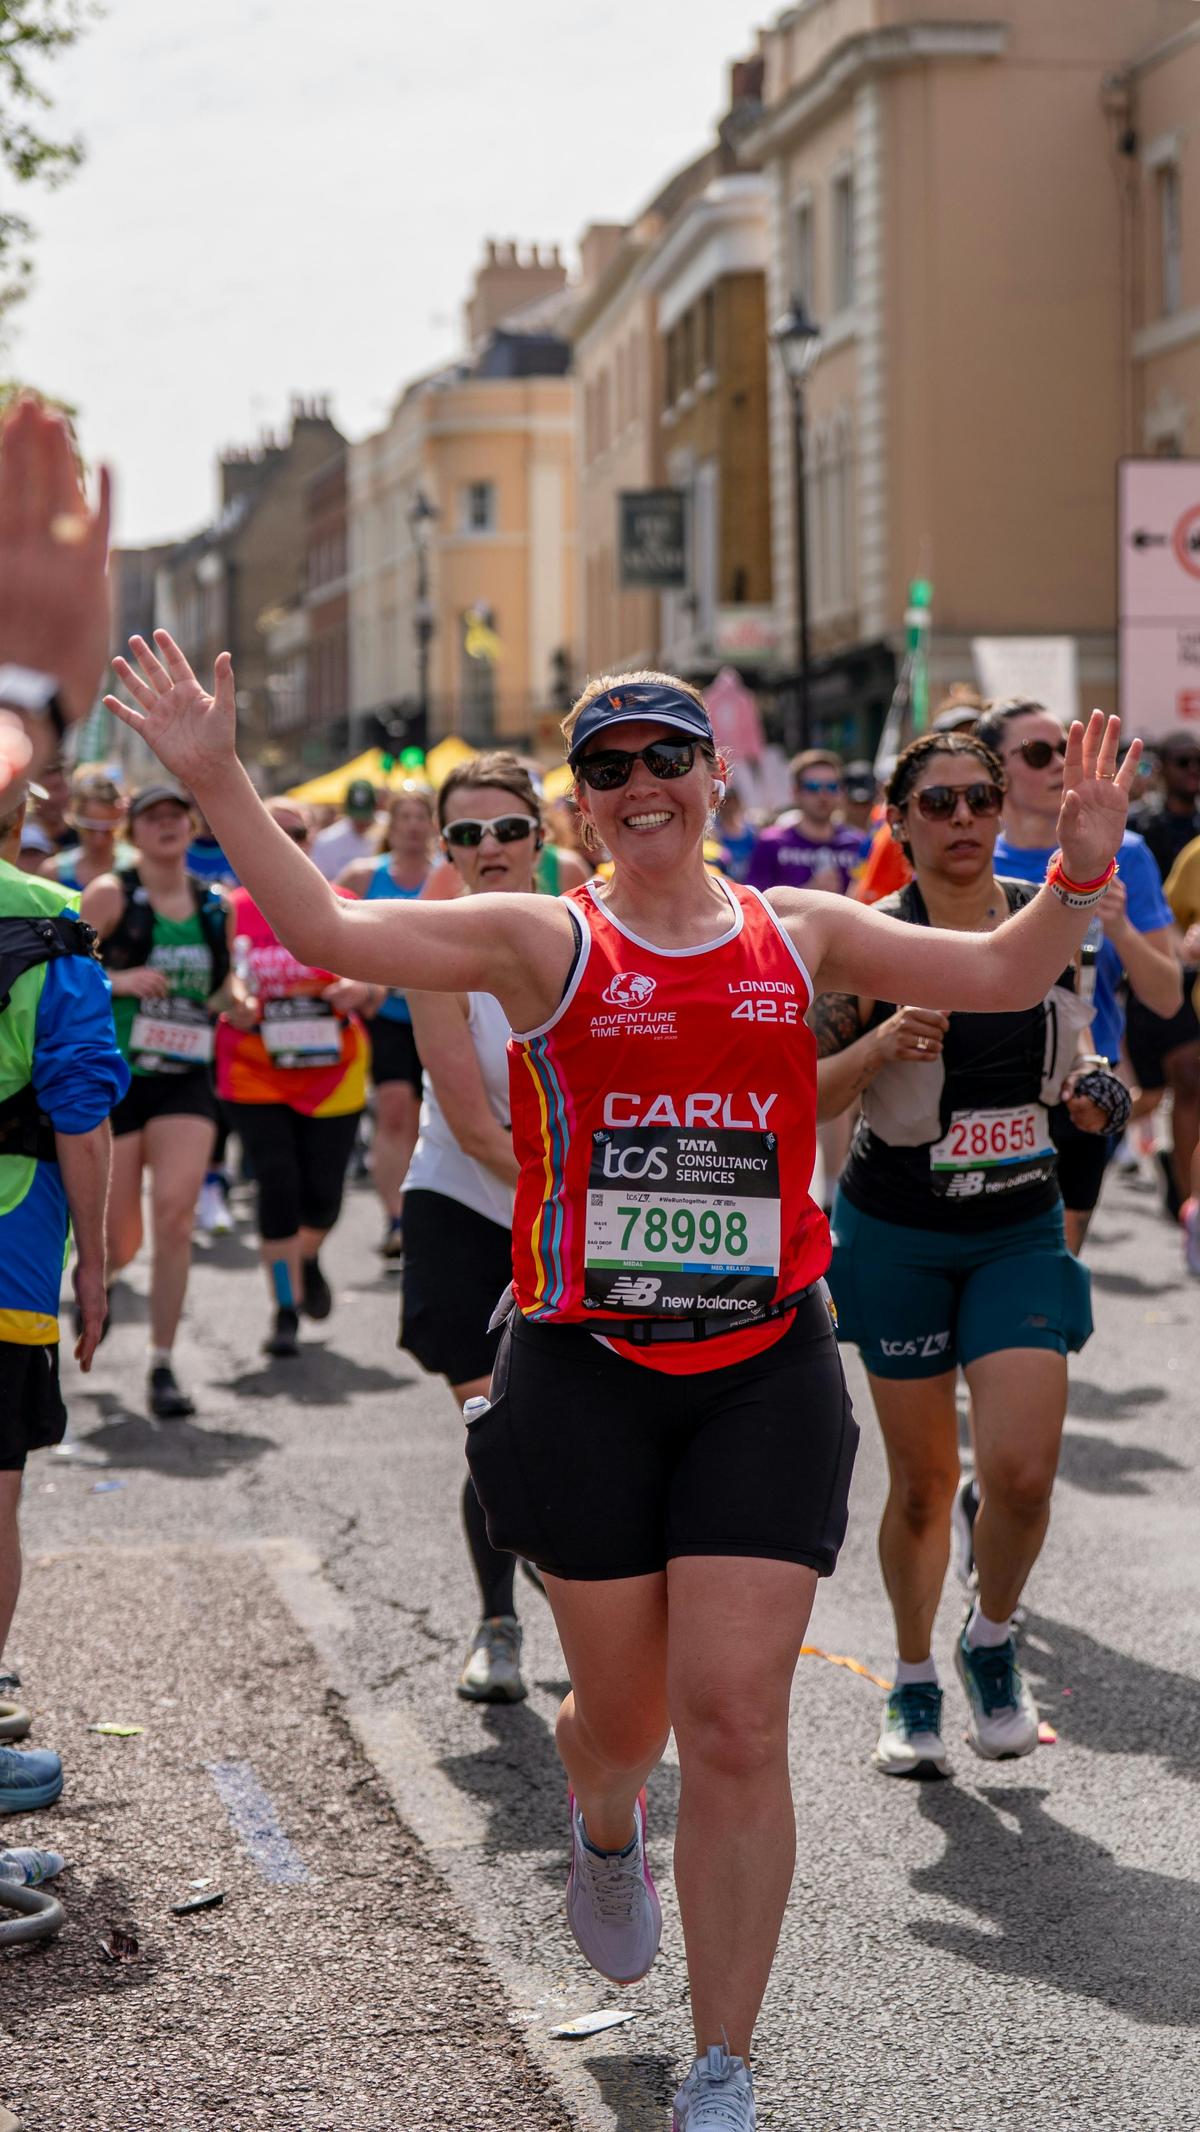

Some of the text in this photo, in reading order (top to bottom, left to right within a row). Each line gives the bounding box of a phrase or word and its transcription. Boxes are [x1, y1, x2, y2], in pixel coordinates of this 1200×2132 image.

[728, 980, 796, 995] LONDON
[590, 1011, 678, 1027] ADVENTURE
[731, 999, 799, 1024] 42.2
[590, 1023, 678, 1038] TIME TRAVEL
[603, 1091, 779, 1130] CARLY
[949, 1115, 1036, 1158] 28655
[677, 1138, 718, 1153] TATA
[603, 1142, 668, 1180] tcs
[676, 1153, 768, 1171] CONSULTANCY
[676, 1169, 736, 1184] SERVICES
[616, 1206, 749, 1256] 78998
[662, 1294, 758, 1311] new balance
